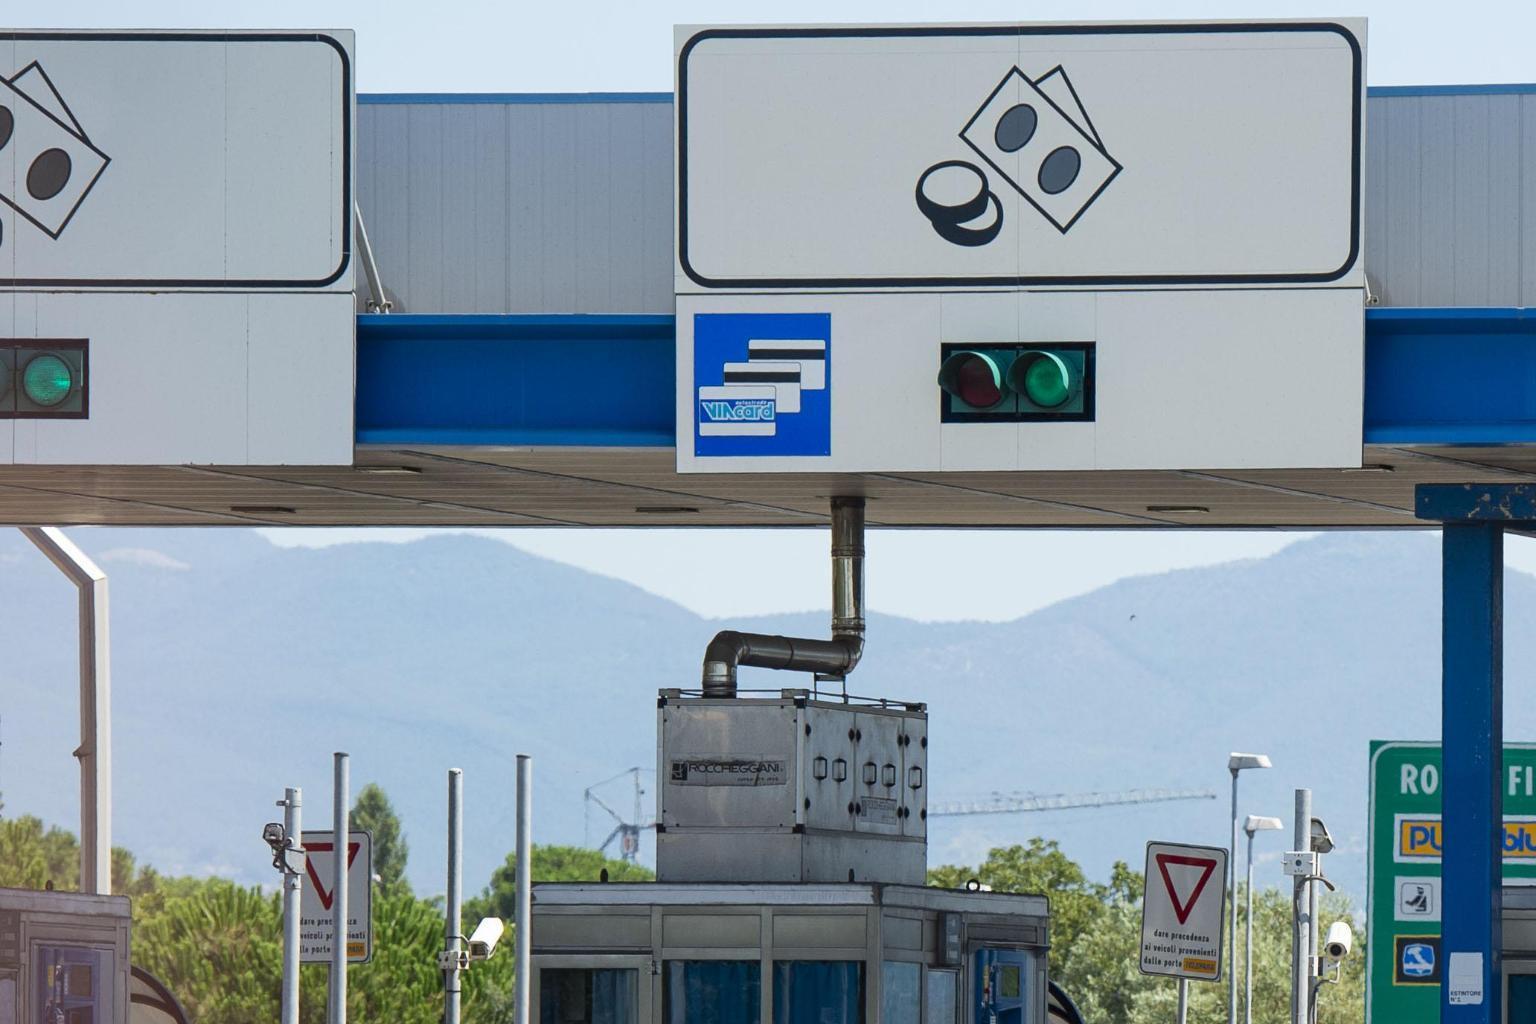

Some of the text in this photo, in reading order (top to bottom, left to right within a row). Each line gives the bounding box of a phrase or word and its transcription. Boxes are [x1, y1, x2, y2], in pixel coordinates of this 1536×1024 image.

[1154, 929, 1210, 942] dare precedenza
[1144, 943, 1217, 957] ai veicoli provenienti
[1144, 956, 1162, 965] dalle
[1163, 959, 1182, 968] porte
